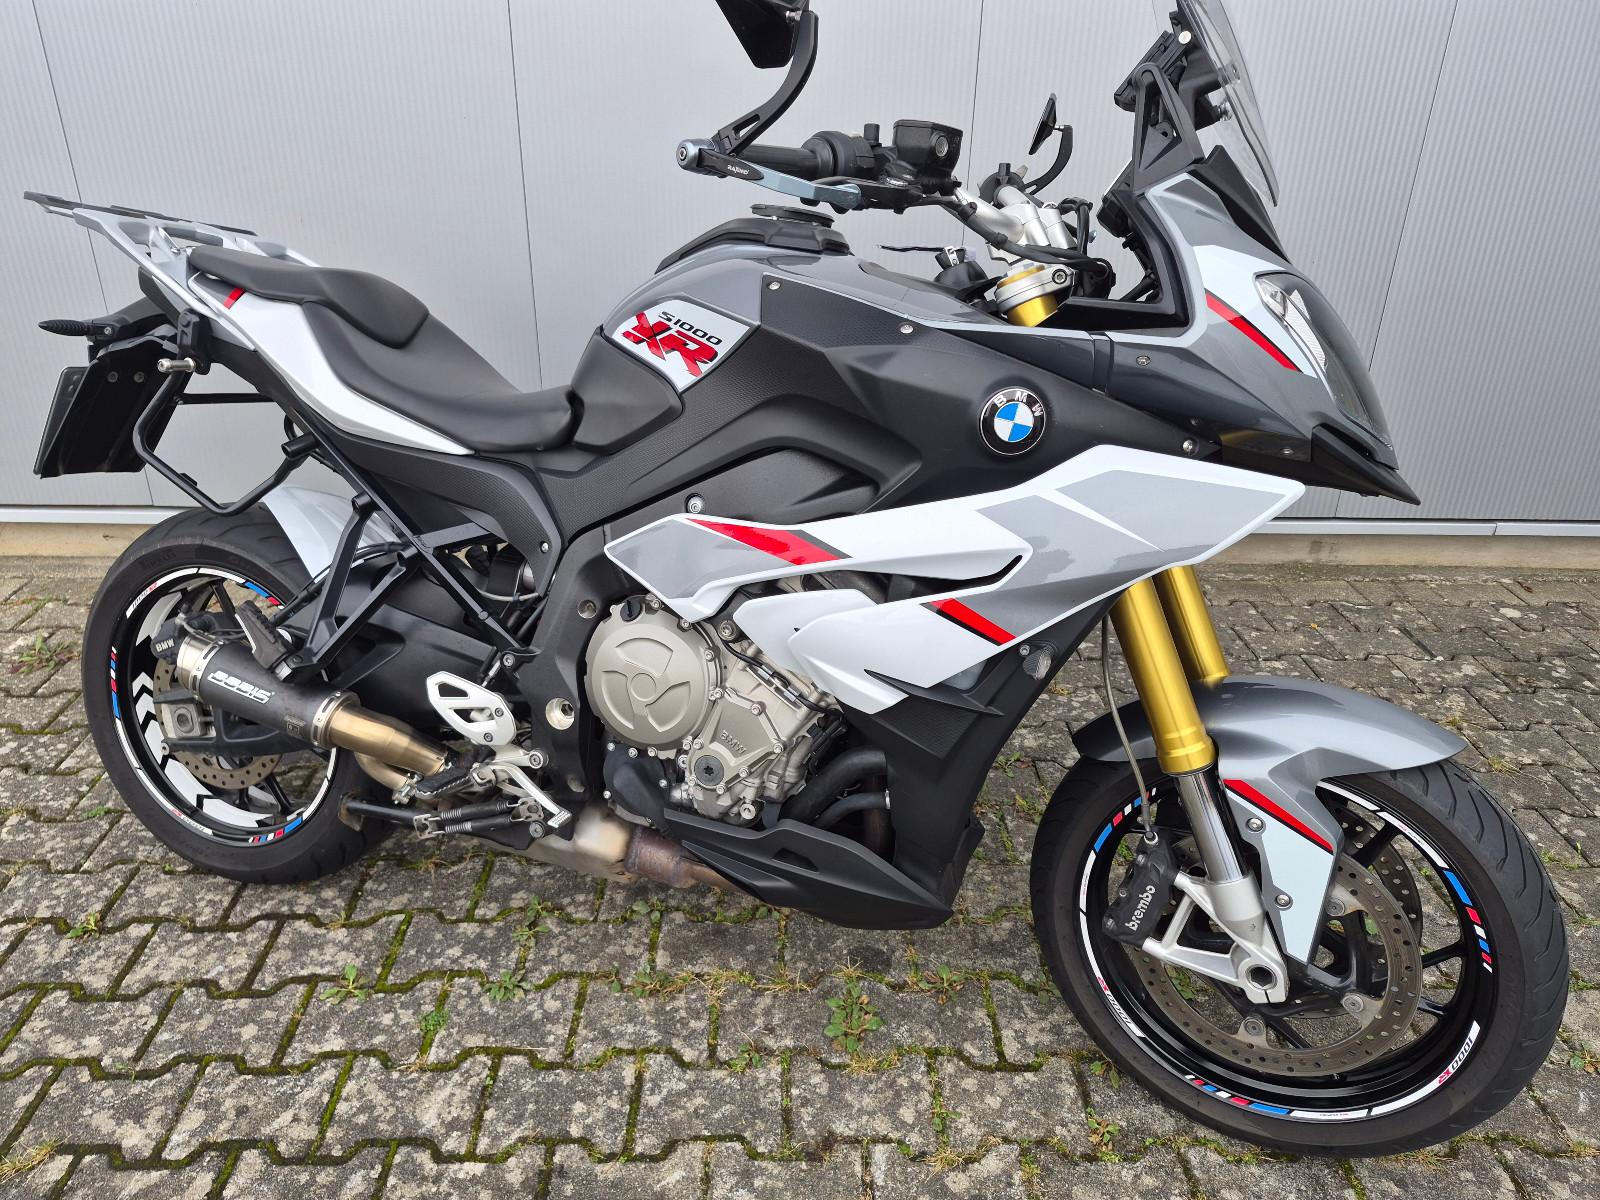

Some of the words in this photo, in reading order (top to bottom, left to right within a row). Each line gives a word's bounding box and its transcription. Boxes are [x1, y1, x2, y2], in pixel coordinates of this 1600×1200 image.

[658, 311, 722, 346] S1000
[622, 311, 719, 377] XR
[993, 391, 1043, 417] BMW
[155, 638, 175, 653] BMW
[720, 729, 747, 754] BMW
[1124, 884, 1156, 932] brembo
